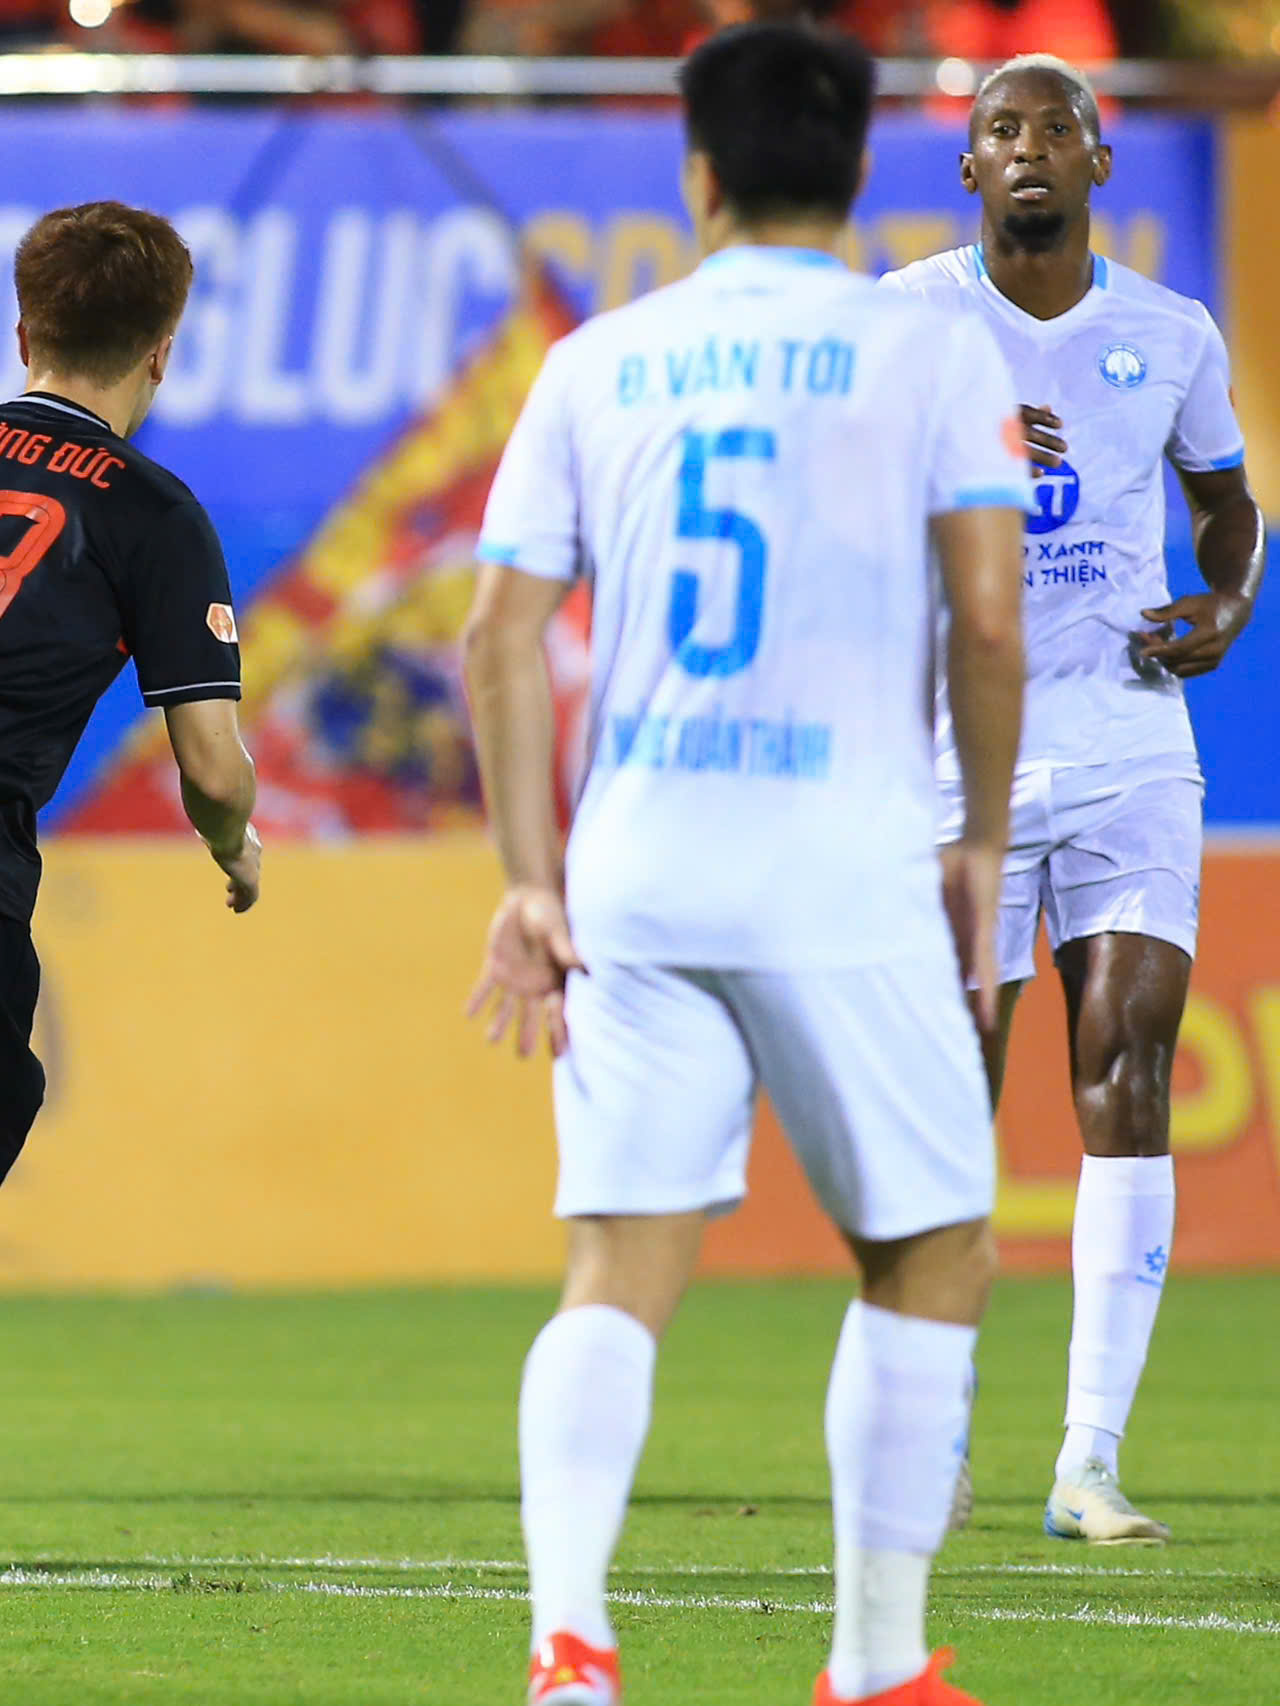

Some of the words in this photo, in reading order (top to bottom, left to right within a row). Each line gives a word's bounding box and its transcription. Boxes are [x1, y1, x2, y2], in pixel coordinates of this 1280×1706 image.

[46, 440, 127, 489] ĐỨC
[667, 426, 777, 679] 5
[1037, 540, 1105, 561] XANH
[1040, 558, 1107, 589] THIỆN
